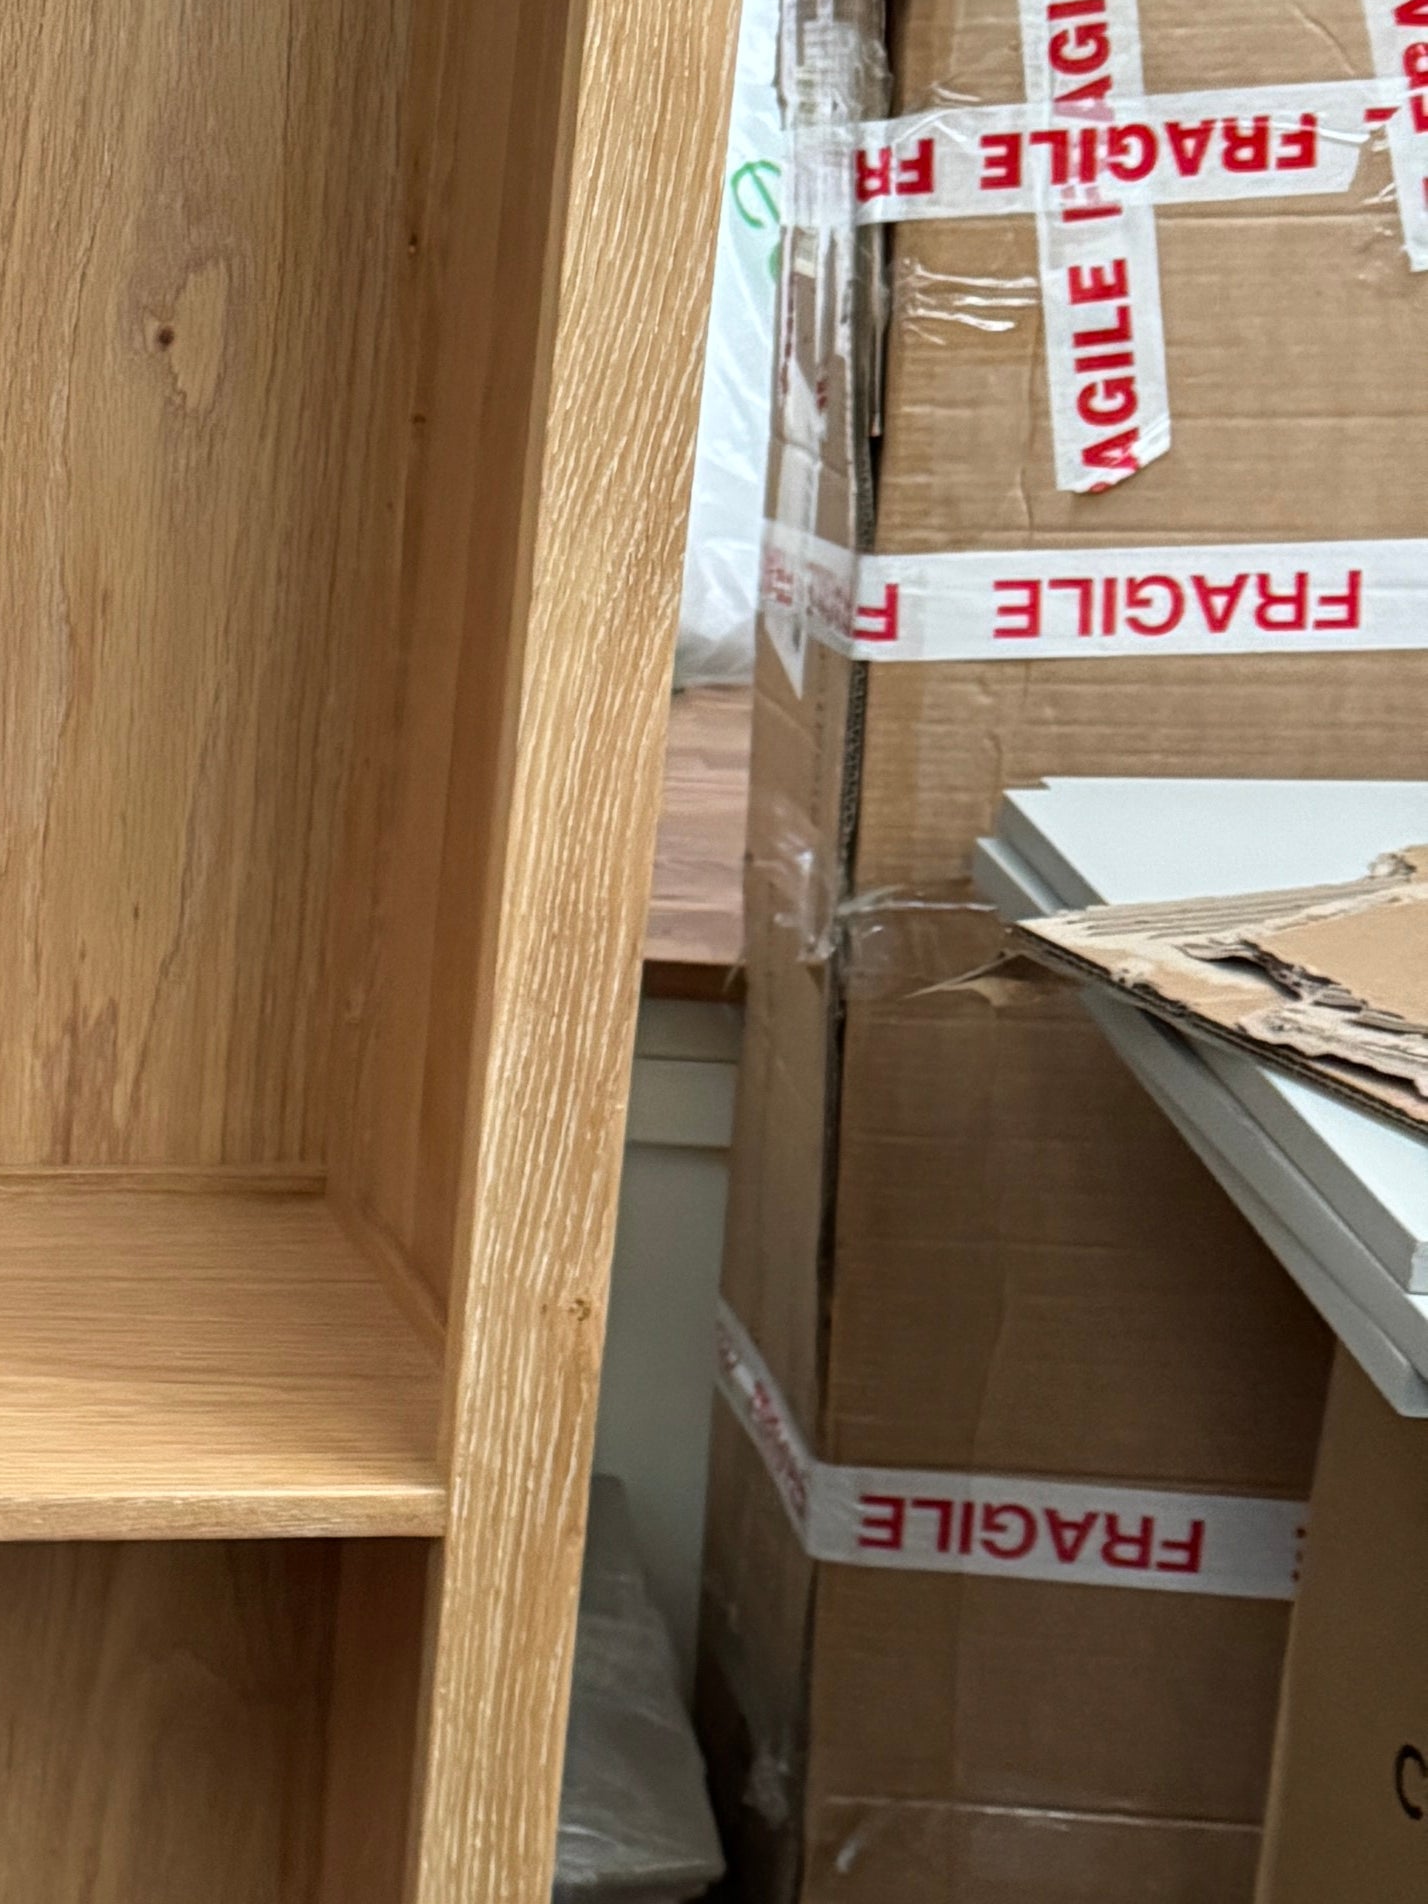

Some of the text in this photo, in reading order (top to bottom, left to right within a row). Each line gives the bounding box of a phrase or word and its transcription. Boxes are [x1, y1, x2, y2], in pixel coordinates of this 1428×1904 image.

[980, 112, 1320, 191] FRAGILE
[993, 569, 1363, 641] FRAGILE
[856, 1494, 1206, 1575] FRAGILE
